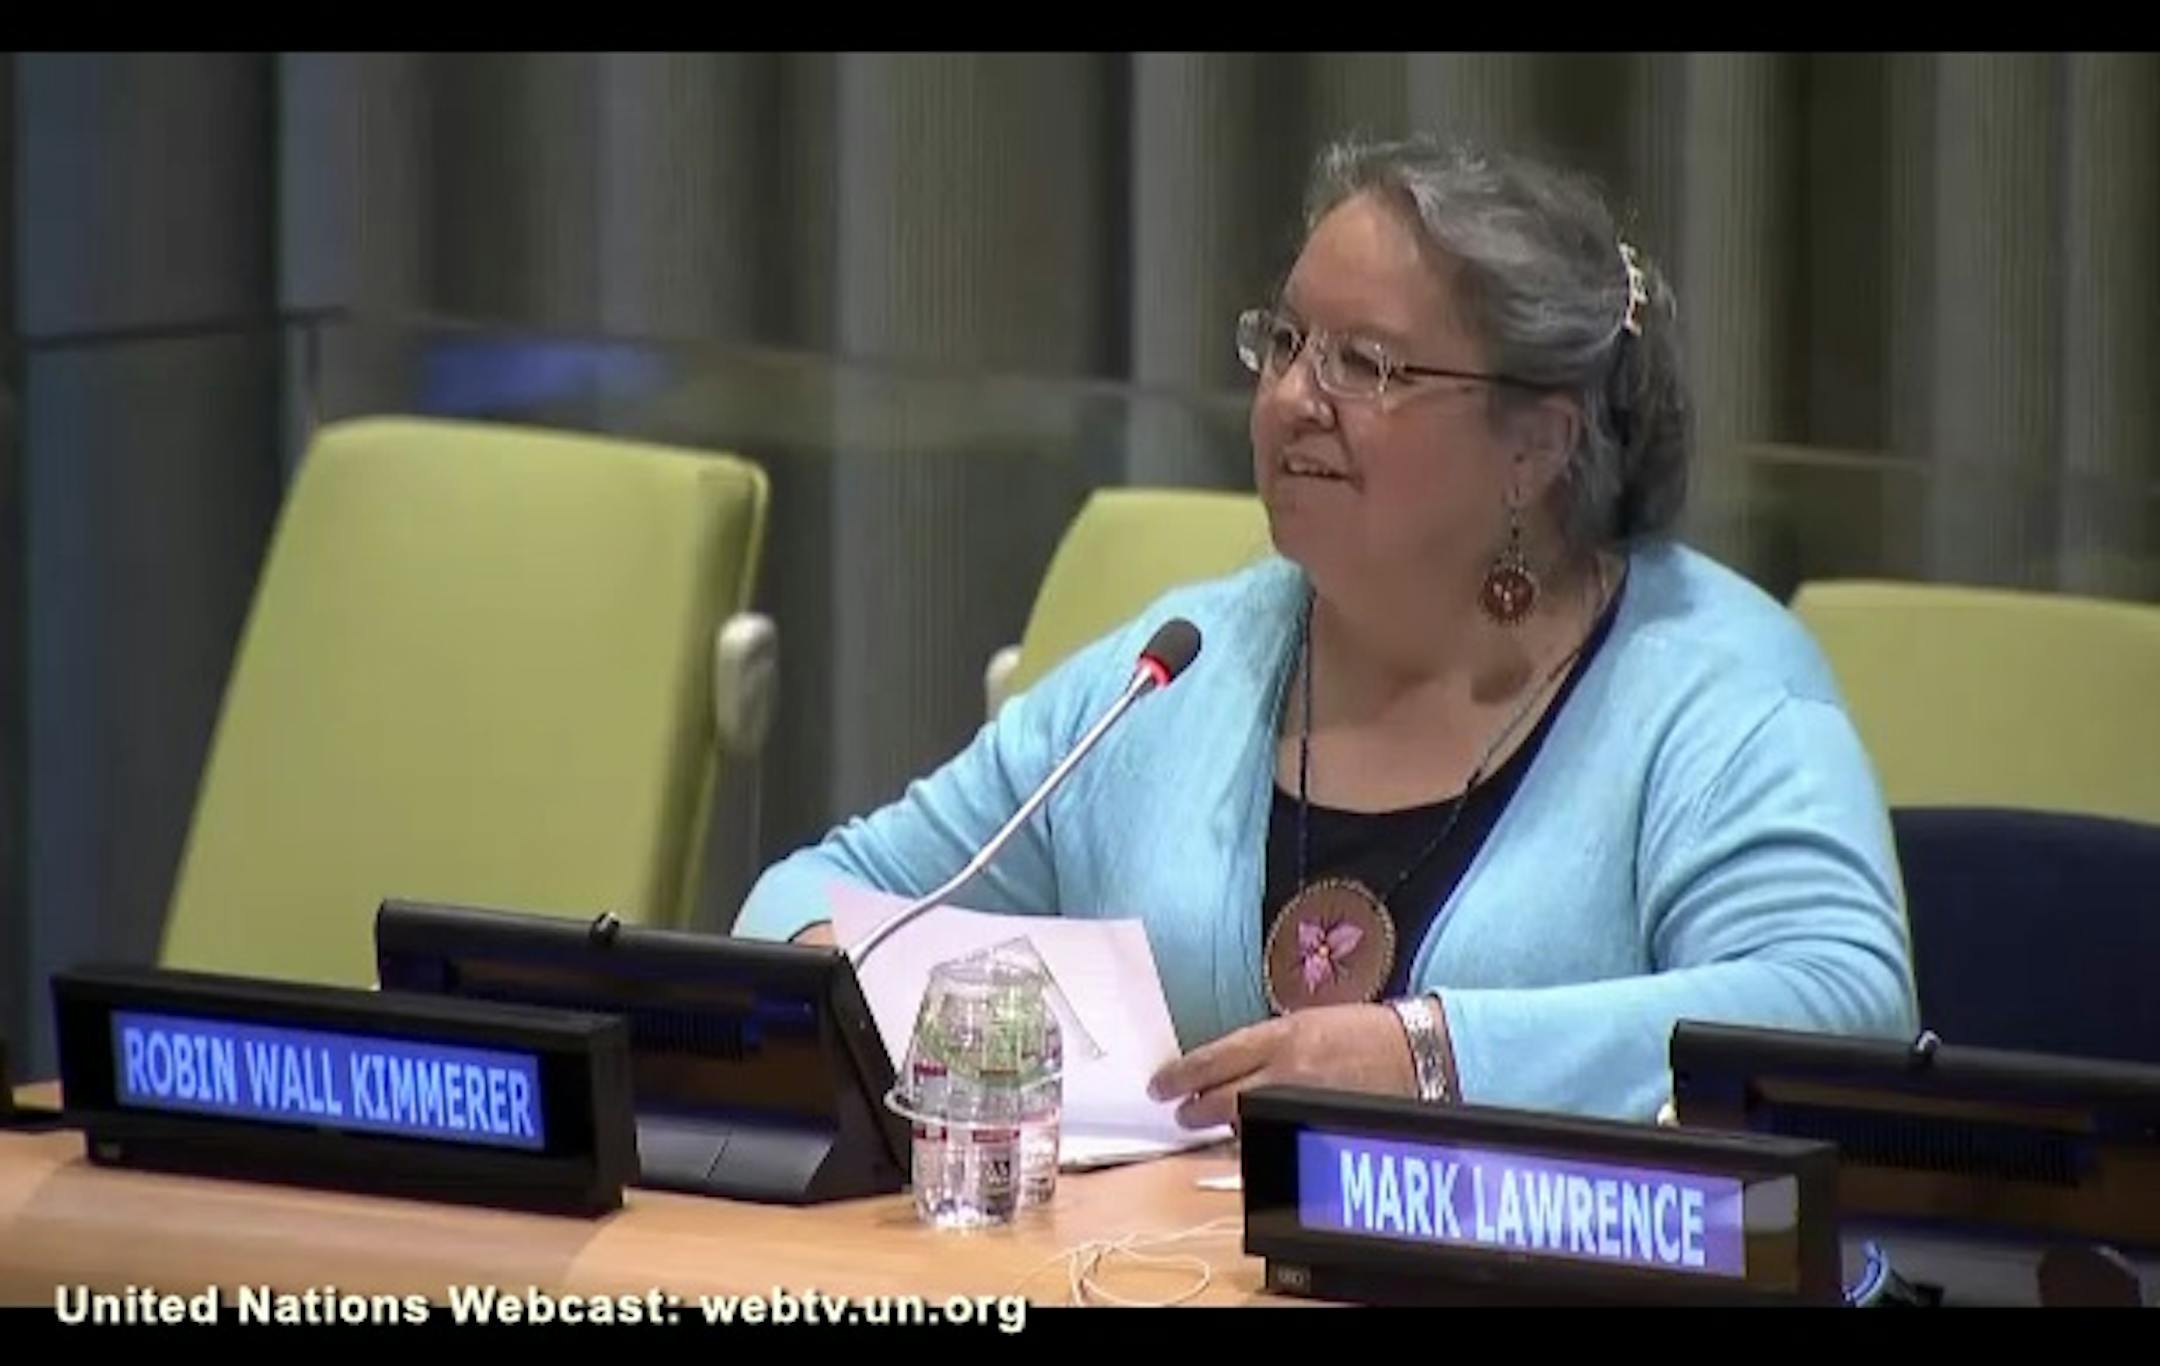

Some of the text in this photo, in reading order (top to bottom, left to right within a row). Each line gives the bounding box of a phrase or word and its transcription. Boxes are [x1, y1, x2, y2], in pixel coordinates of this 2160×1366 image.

[123, 1028, 535, 1137] ROBIN WALL KIMMERER
[1339, 1149, 1706, 1268] MARK LAWRENCE
